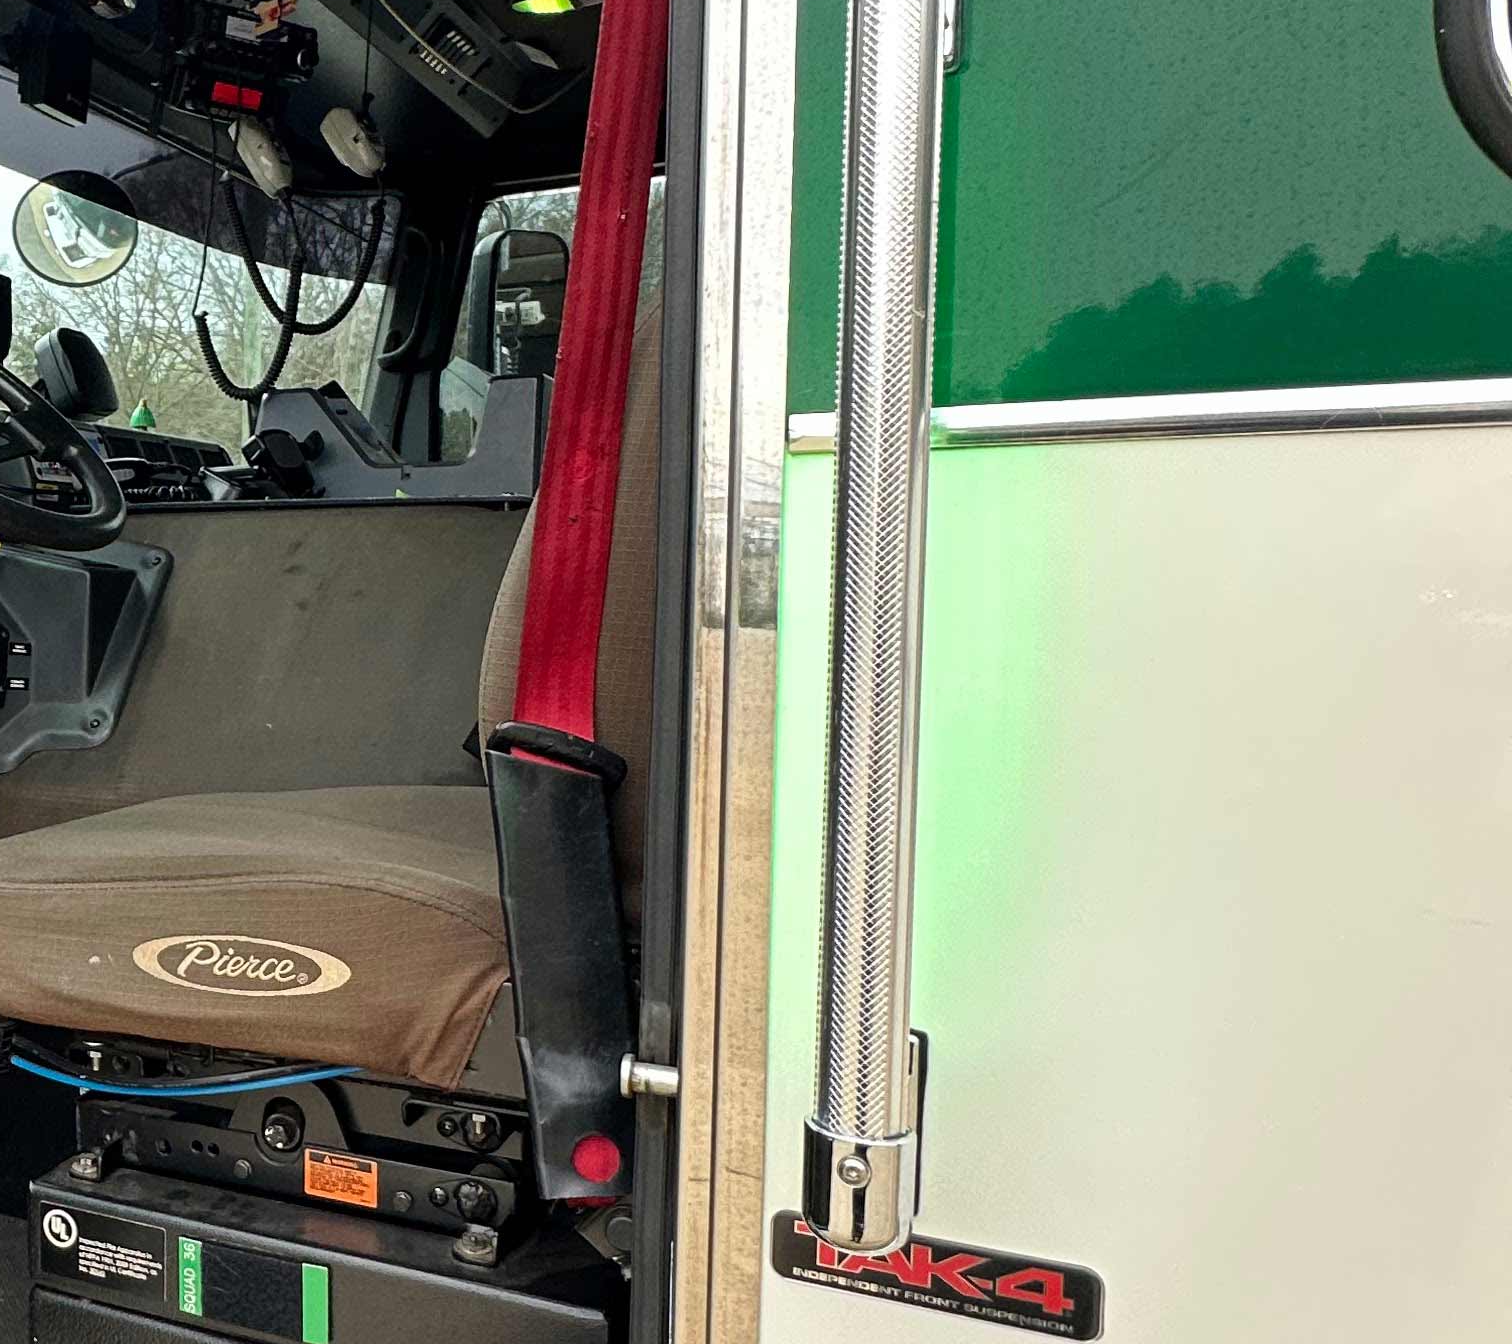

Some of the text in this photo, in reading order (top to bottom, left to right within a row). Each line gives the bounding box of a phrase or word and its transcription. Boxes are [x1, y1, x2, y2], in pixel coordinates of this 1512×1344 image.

[177, 941, 296, 983] Pierce
[50, 1215, 70, 1241] UL
[183, 1242, 196, 1314] SQUAD 36
[792, 1266, 1075, 1335] INDEPENDENT FRONT SUSPENSION
